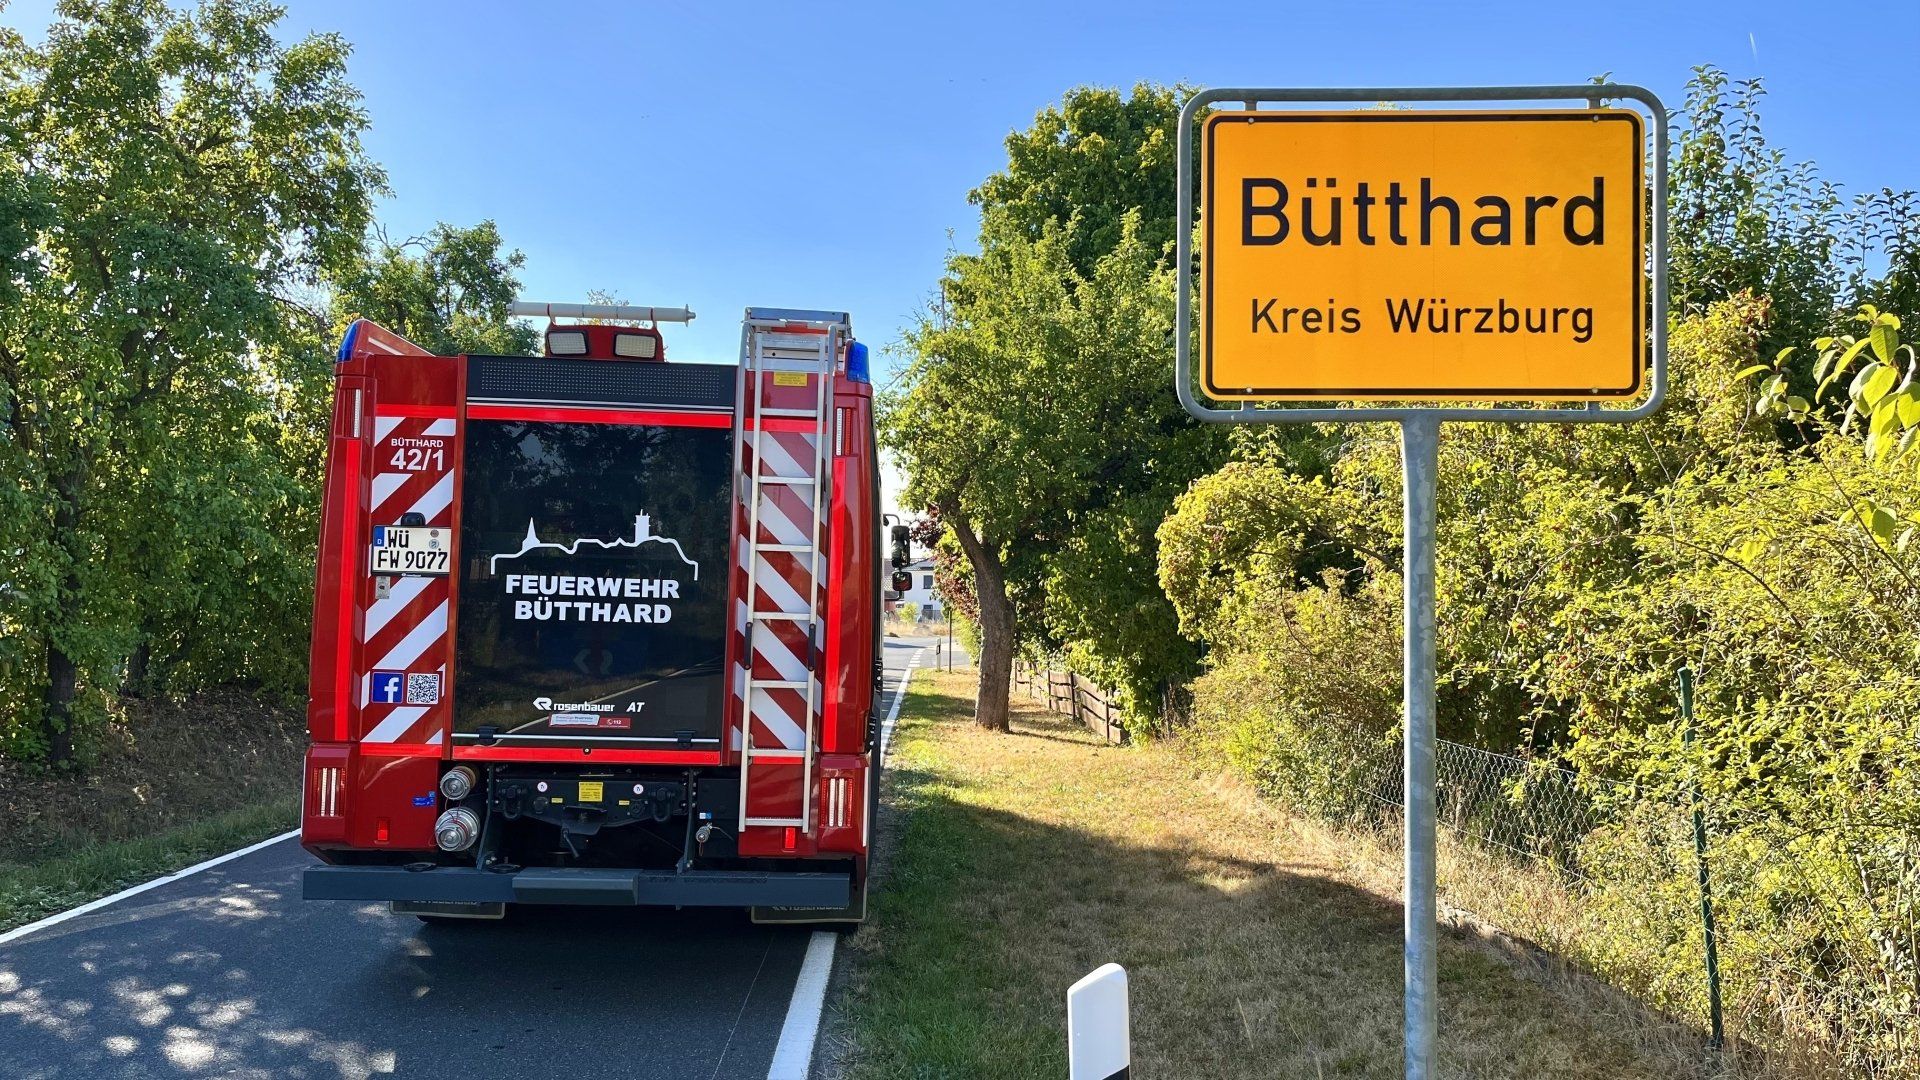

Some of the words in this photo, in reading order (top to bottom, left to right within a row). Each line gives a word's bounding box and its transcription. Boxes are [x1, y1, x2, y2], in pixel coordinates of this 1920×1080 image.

[1241, 176, 1605, 247] Bütthard
[1251, 297, 1362, 334] Kreis
[1385, 297, 1594, 343] Würzburg
[390, 437, 444, 448] BÜTTHARD
[390, 448, 444, 471] 42/1
[387, 529, 410, 549] WÜ
[377, 550, 400, 569] FW
[405, 551, 448, 570] 9077
[505, 574, 680, 599] FEUERWEHR
[514, 596, 672, 624] BÜTTHARD
[553, 700, 615, 712] rosenbauer
[626, 701, 645, 713] AT
